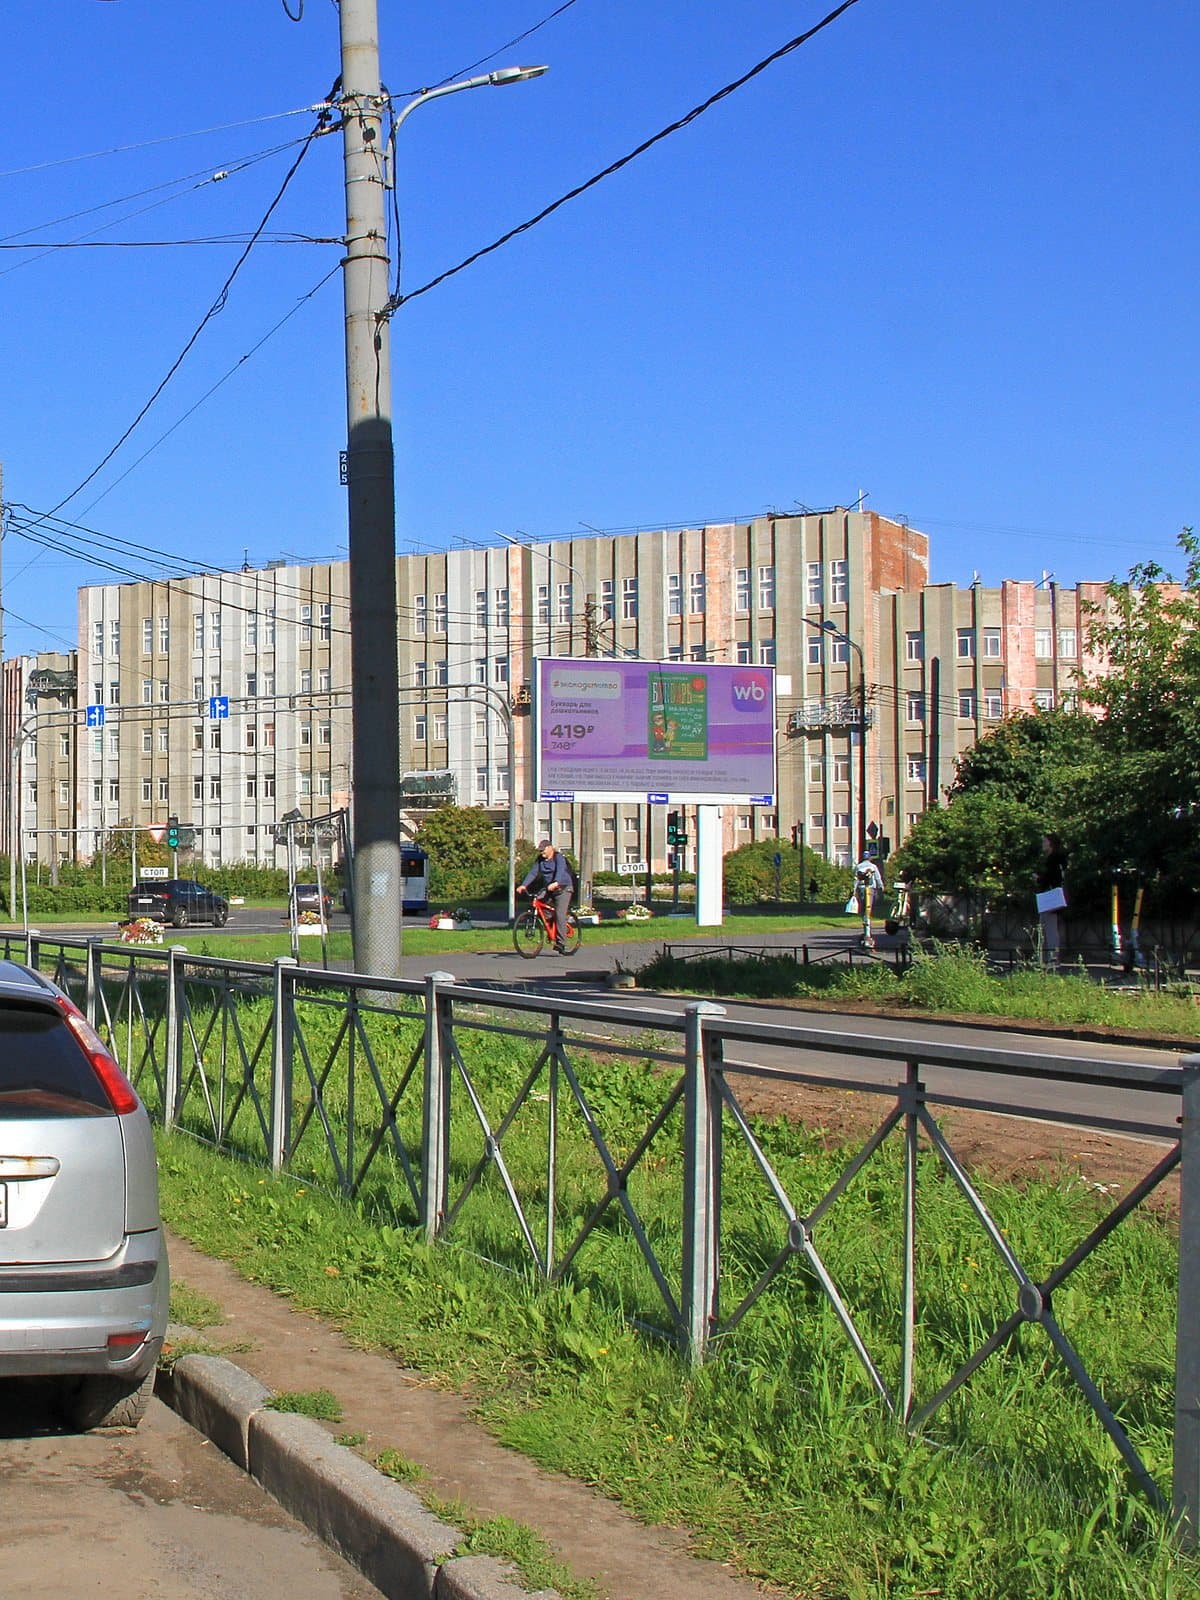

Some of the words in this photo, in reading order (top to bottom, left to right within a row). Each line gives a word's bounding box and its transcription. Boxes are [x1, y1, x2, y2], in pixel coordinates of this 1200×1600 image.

[340, 453, 348, 483] 205
[733, 680, 766, 701] wb
[621, 864, 645, 872] СТОП
